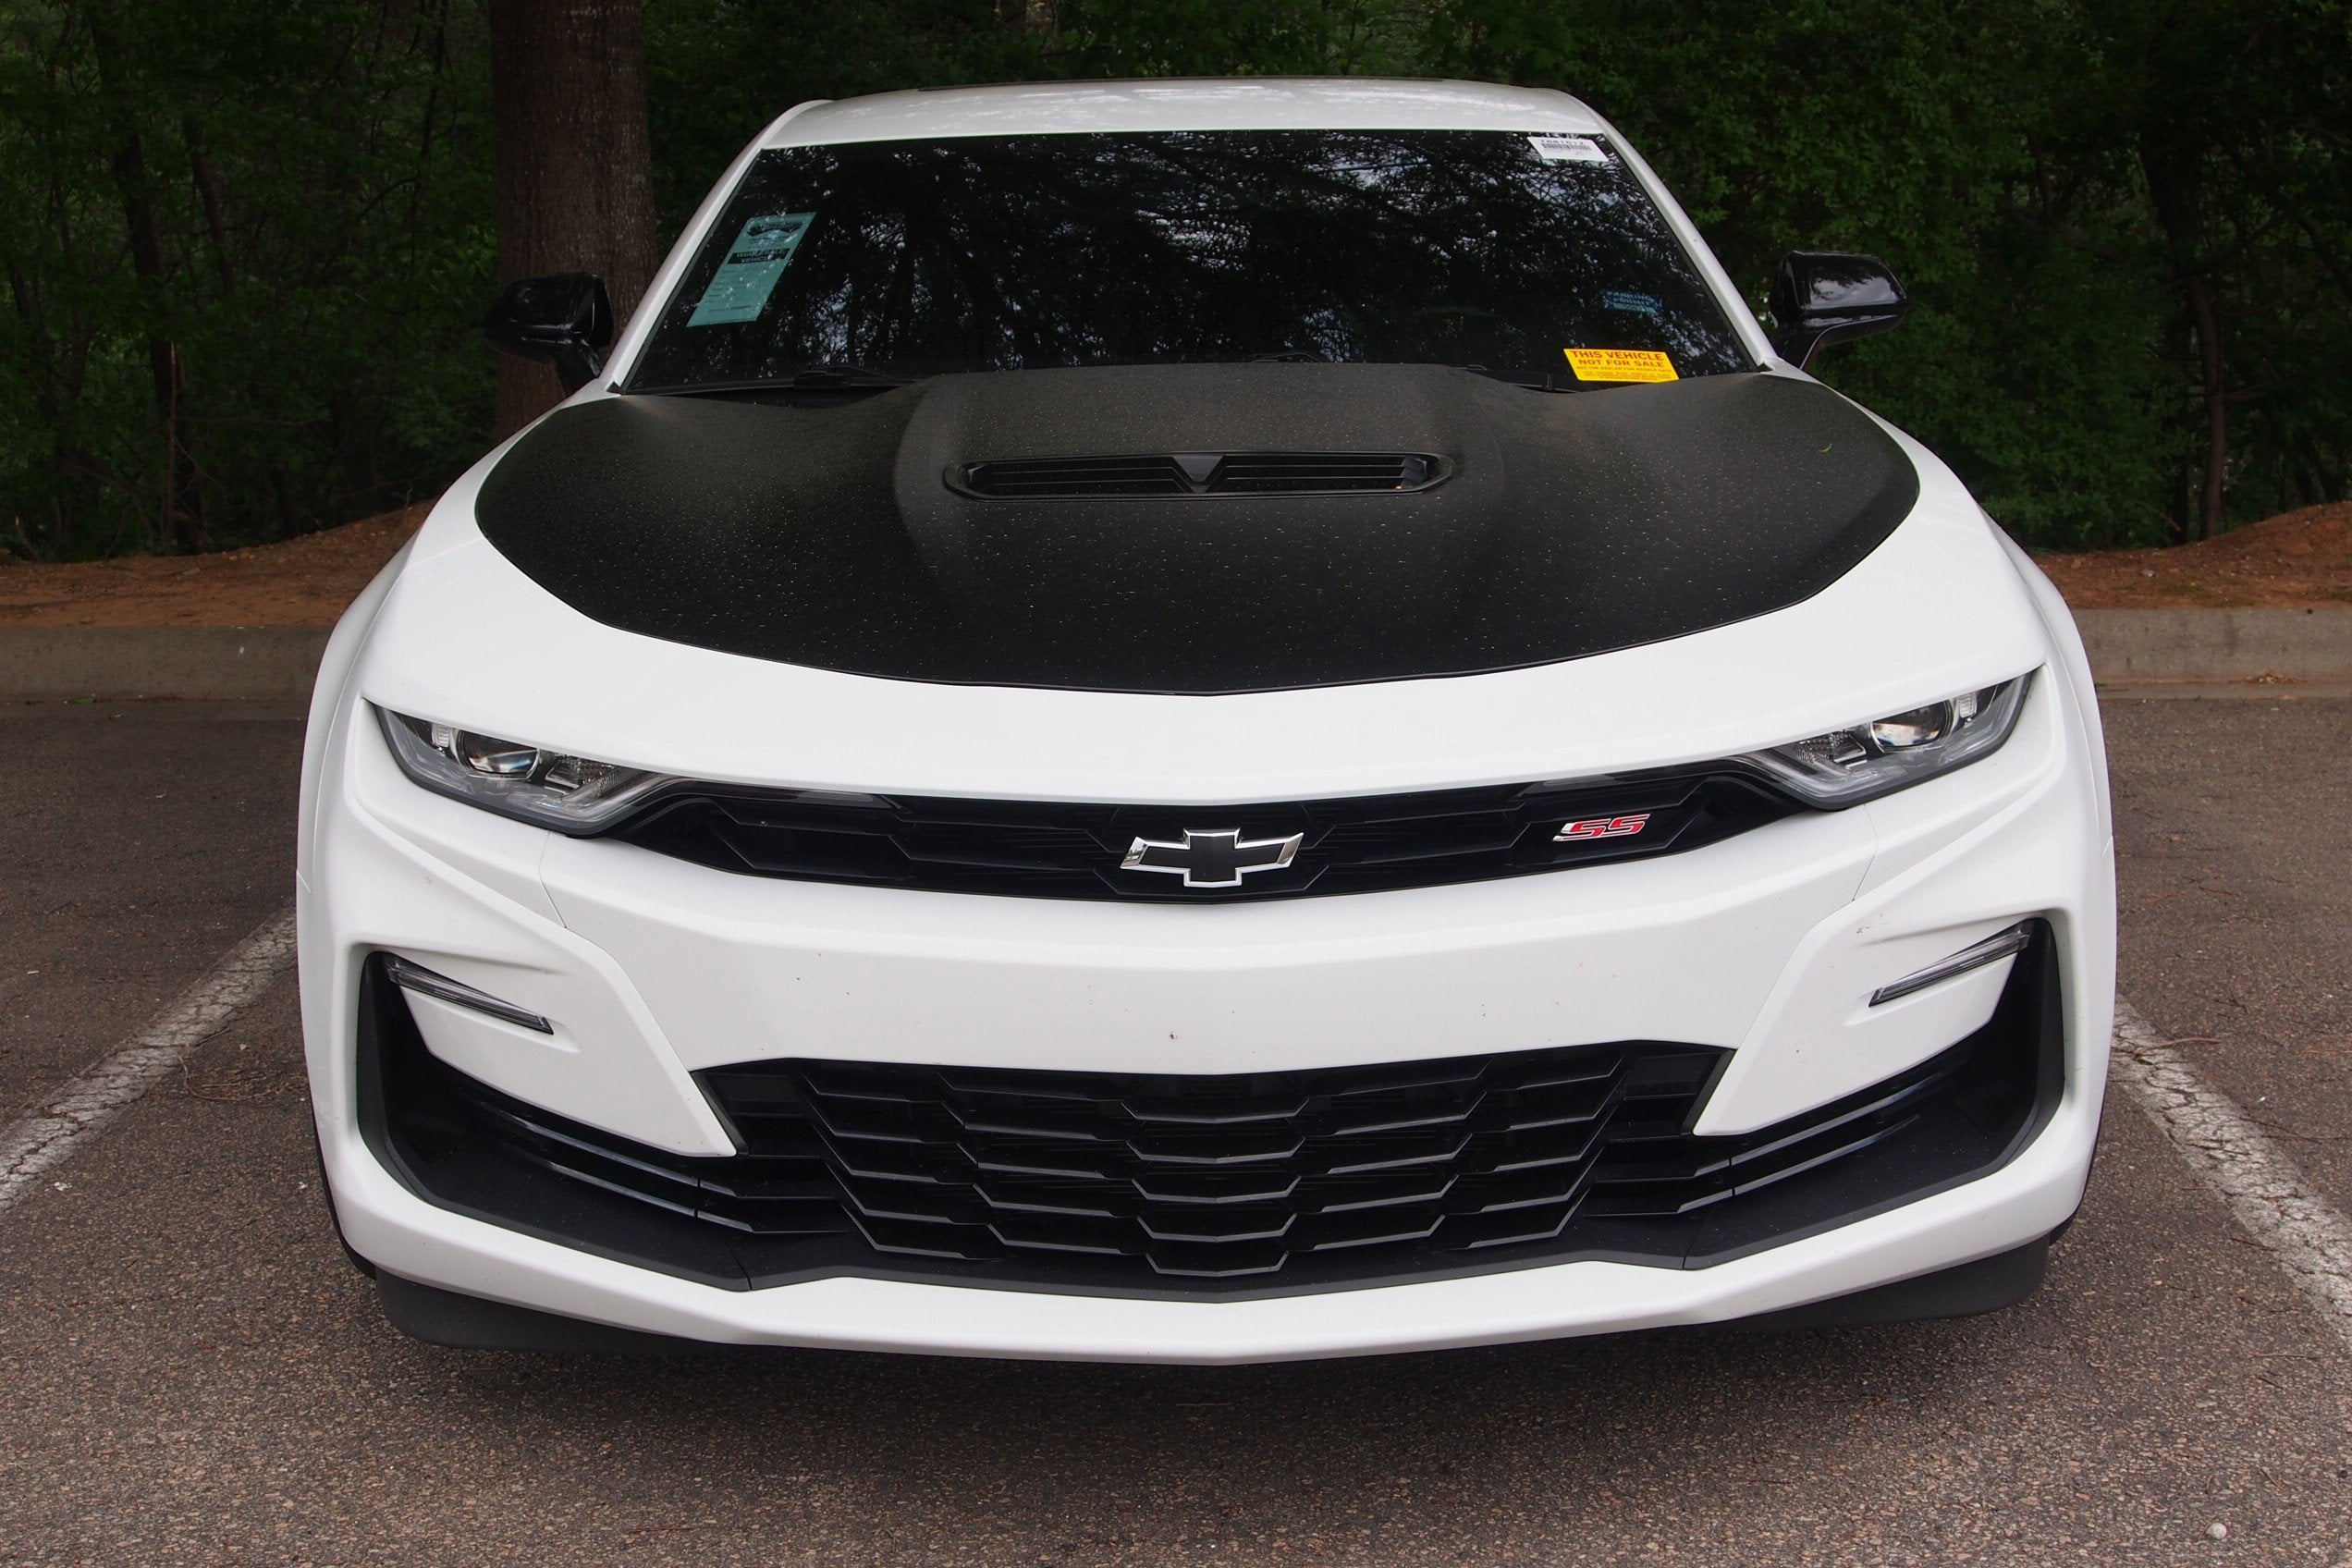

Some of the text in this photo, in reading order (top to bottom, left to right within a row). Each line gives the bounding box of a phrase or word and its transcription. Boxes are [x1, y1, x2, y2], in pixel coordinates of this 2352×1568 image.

[1607, 291, 1655, 301] PARKING
[1570, 350, 1663, 361] THIS VEHICLE
[1552, 813, 1651, 842] SS
